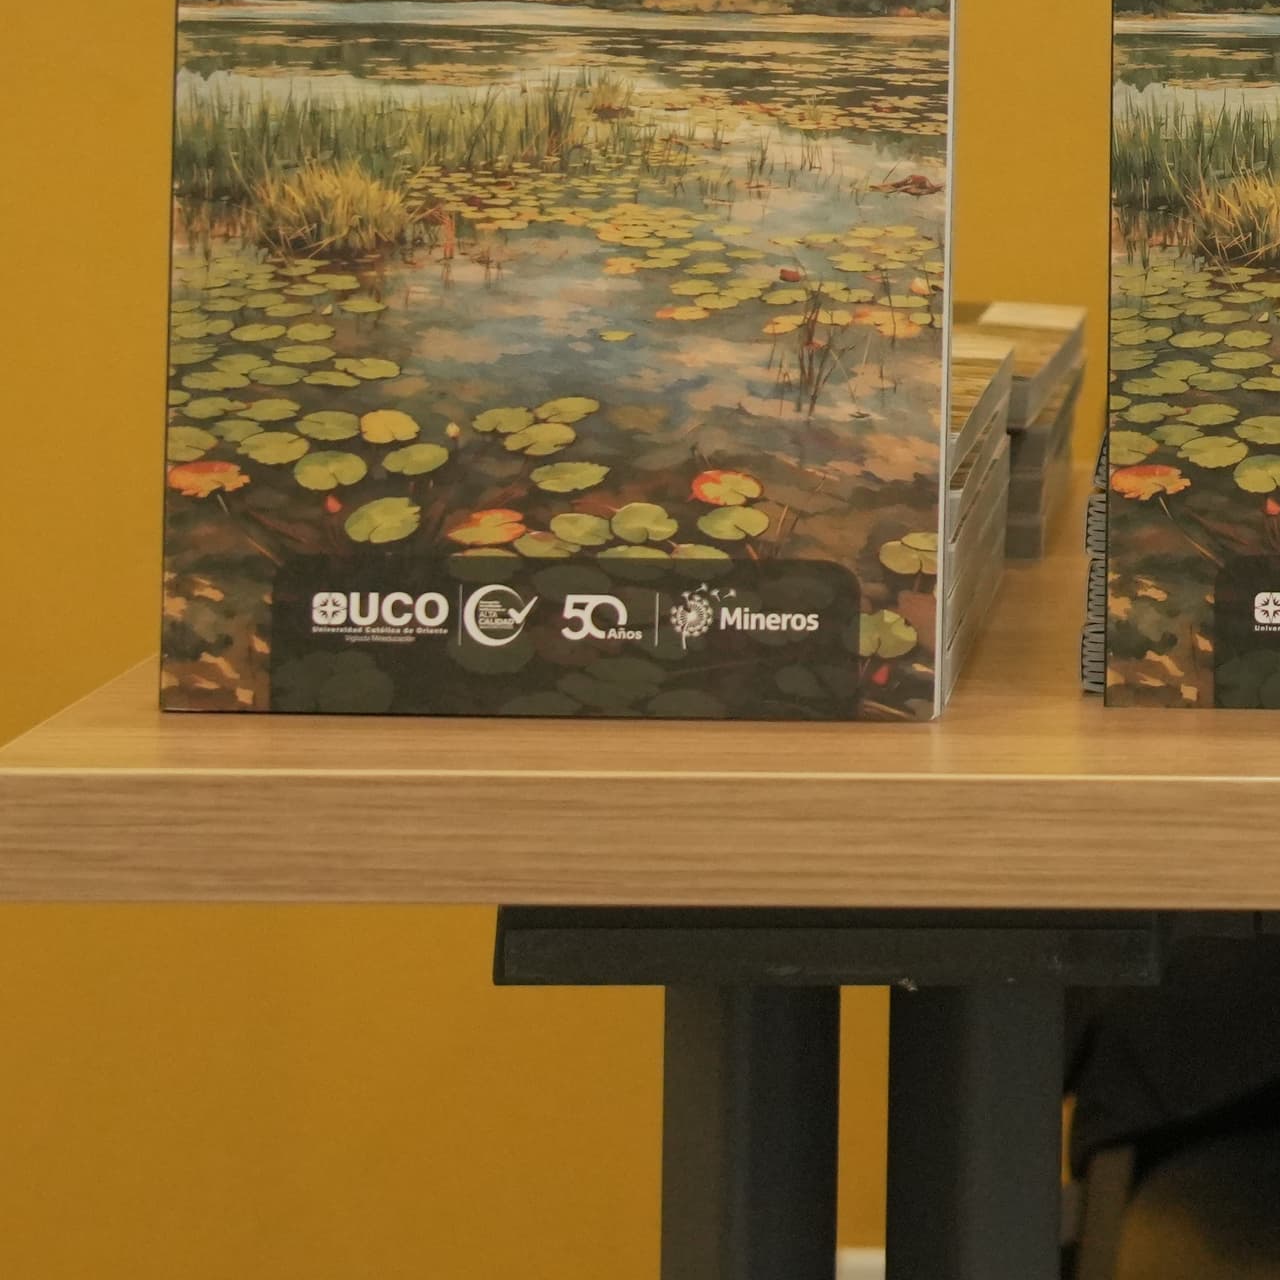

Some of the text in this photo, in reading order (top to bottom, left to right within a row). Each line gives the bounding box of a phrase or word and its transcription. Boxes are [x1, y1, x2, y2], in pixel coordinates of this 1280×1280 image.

[349, 591, 450, 627] UCO
[562, 593, 629, 640] 50
[719, 606, 820, 632] Mineros
[607, 626, 644, 641] Años
